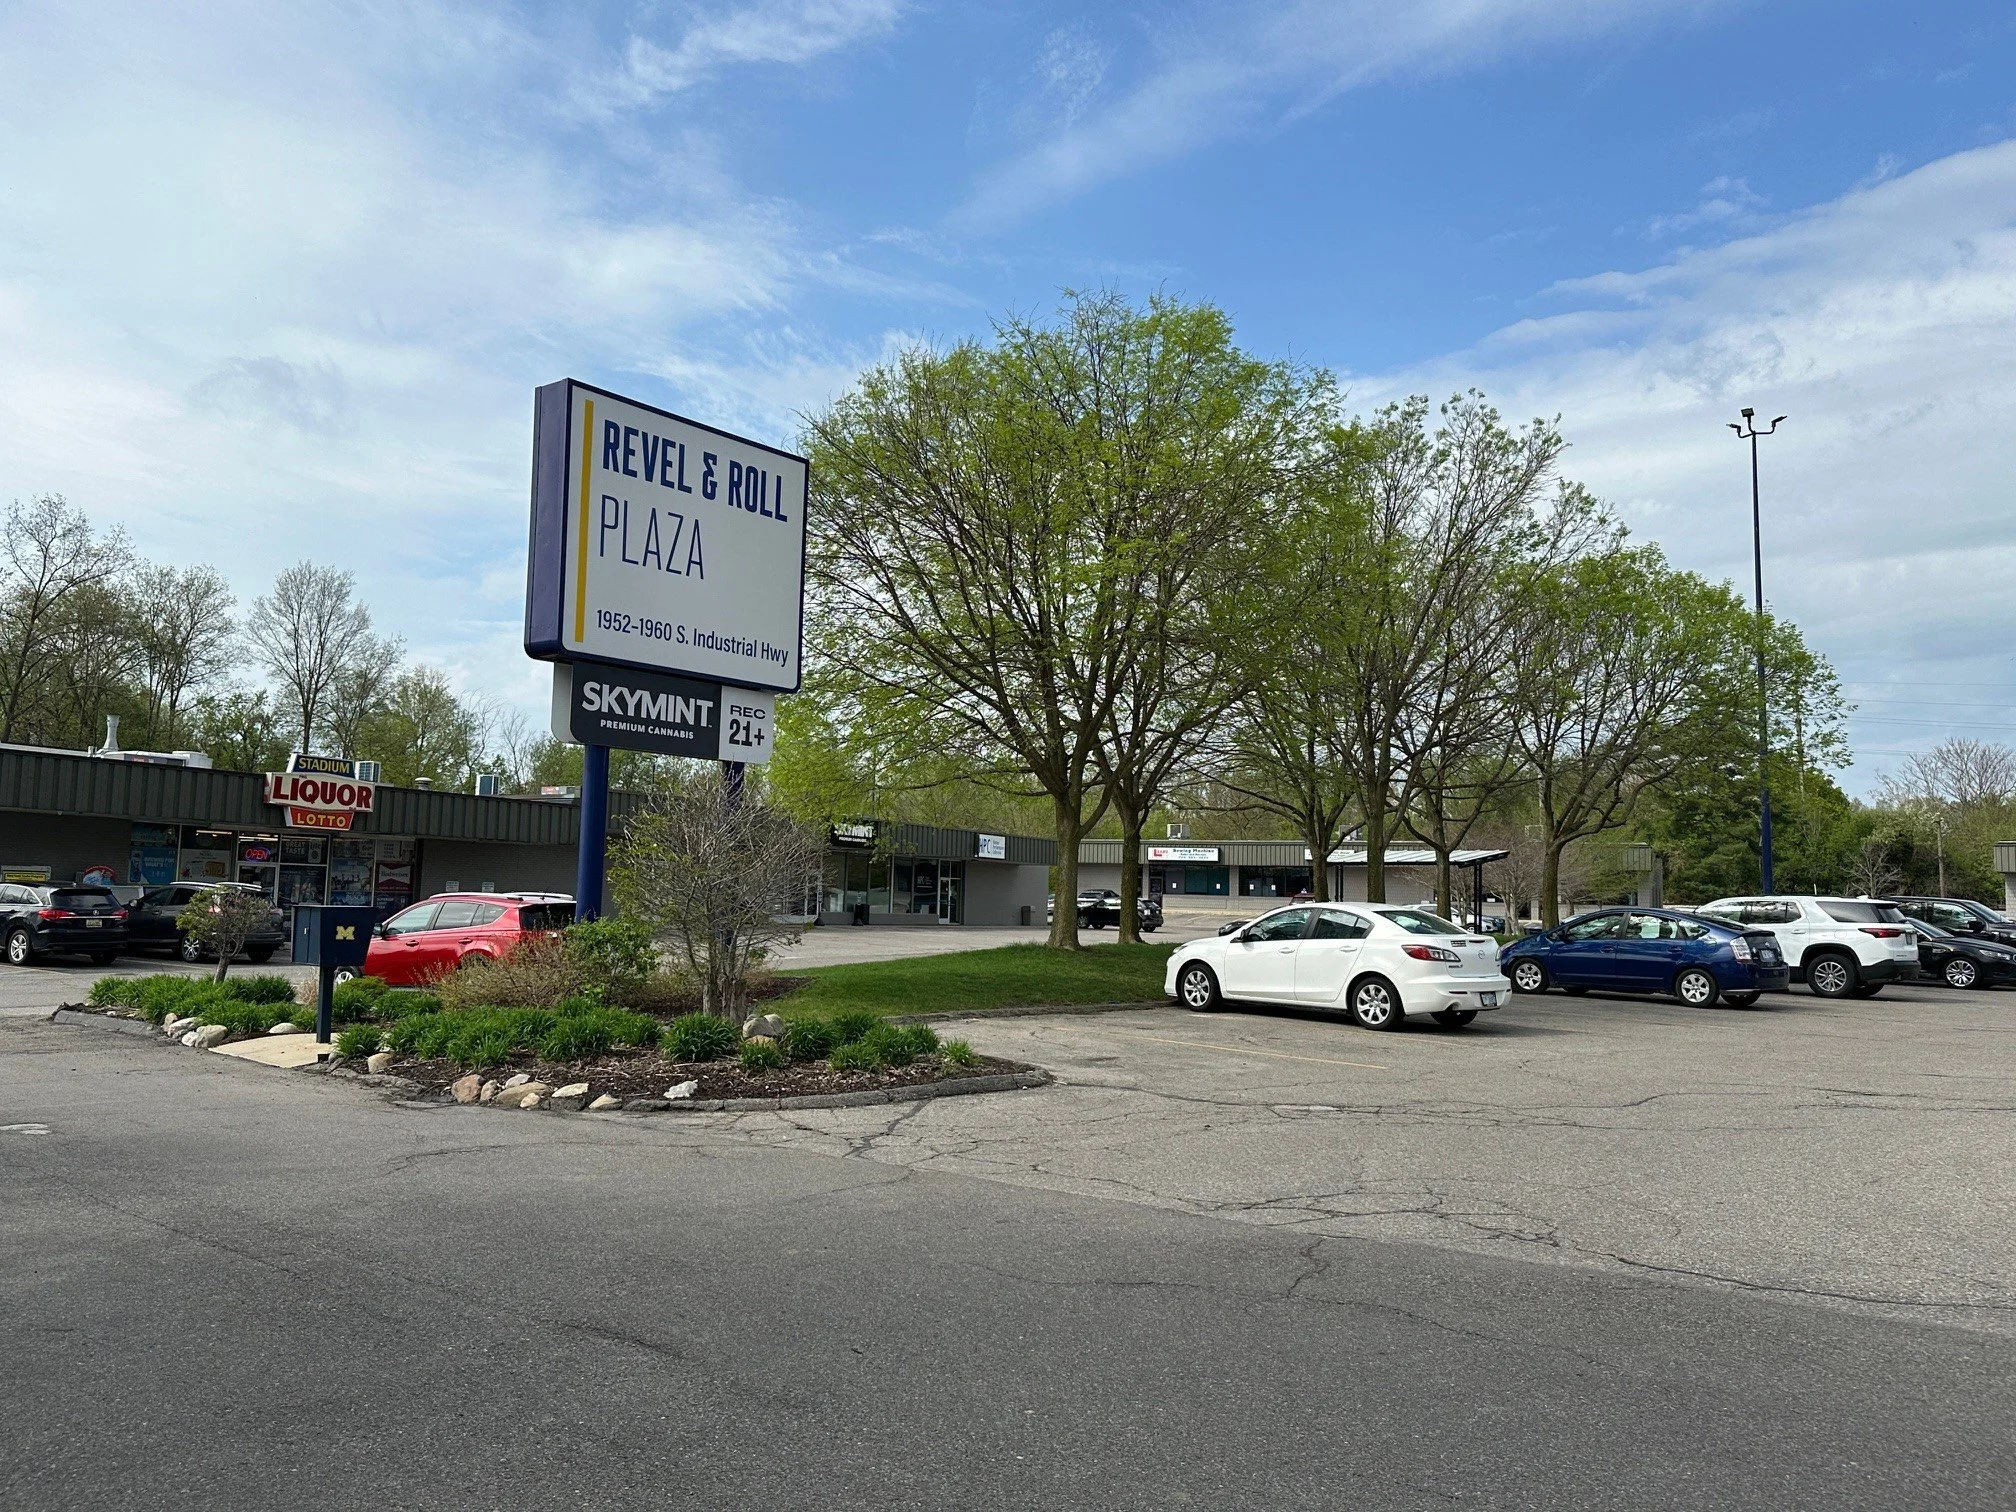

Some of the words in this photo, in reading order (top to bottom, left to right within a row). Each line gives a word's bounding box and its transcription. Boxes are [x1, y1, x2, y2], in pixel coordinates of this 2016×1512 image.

[603, 419, 692, 494] REVEL
[702, 451, 718, 500] &
[728, 459, 788, 523] ROLL
[600, 494, 704, 580] PLAZA
[597, 609, 672, 642] 1952-1960
[676, 625, 689, 645] S.
[693, 628, 757, 658] Industrial
[761, 641, 789, 668] Hwy
[582, 681, 713, 728] SKYMINT
[730, 705, 766, 720] REC
[600, 719, 646, 734] PREMIUM
[648, 725, 694, 740] CANNABIS
[728, 718, 765, 747] 21+
[299, 757, 350, 774] STADIUM
[272, 775, 373, 809] LIQUOR
[297, 812, 346, 828] LOTTO
[245, 848, 269, 860] OPEN
[336, 925, 355, 940] M
